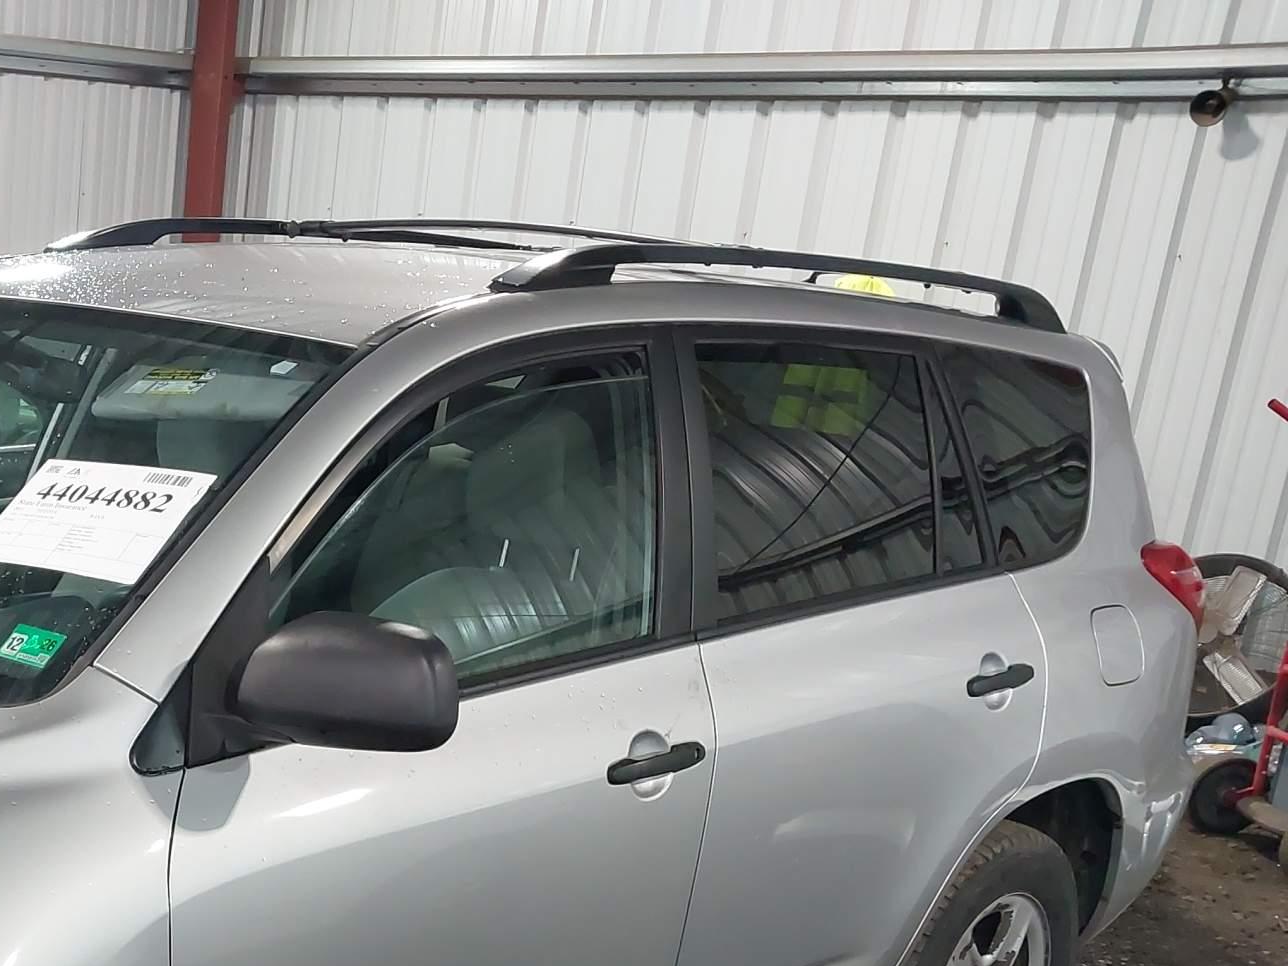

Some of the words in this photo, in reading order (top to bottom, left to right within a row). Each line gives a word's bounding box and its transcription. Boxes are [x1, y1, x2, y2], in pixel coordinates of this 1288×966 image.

[36, 482, 174, 513] 44044882
[6, 635, 24, 651] 12
[40, 638, 58, 652] 26
